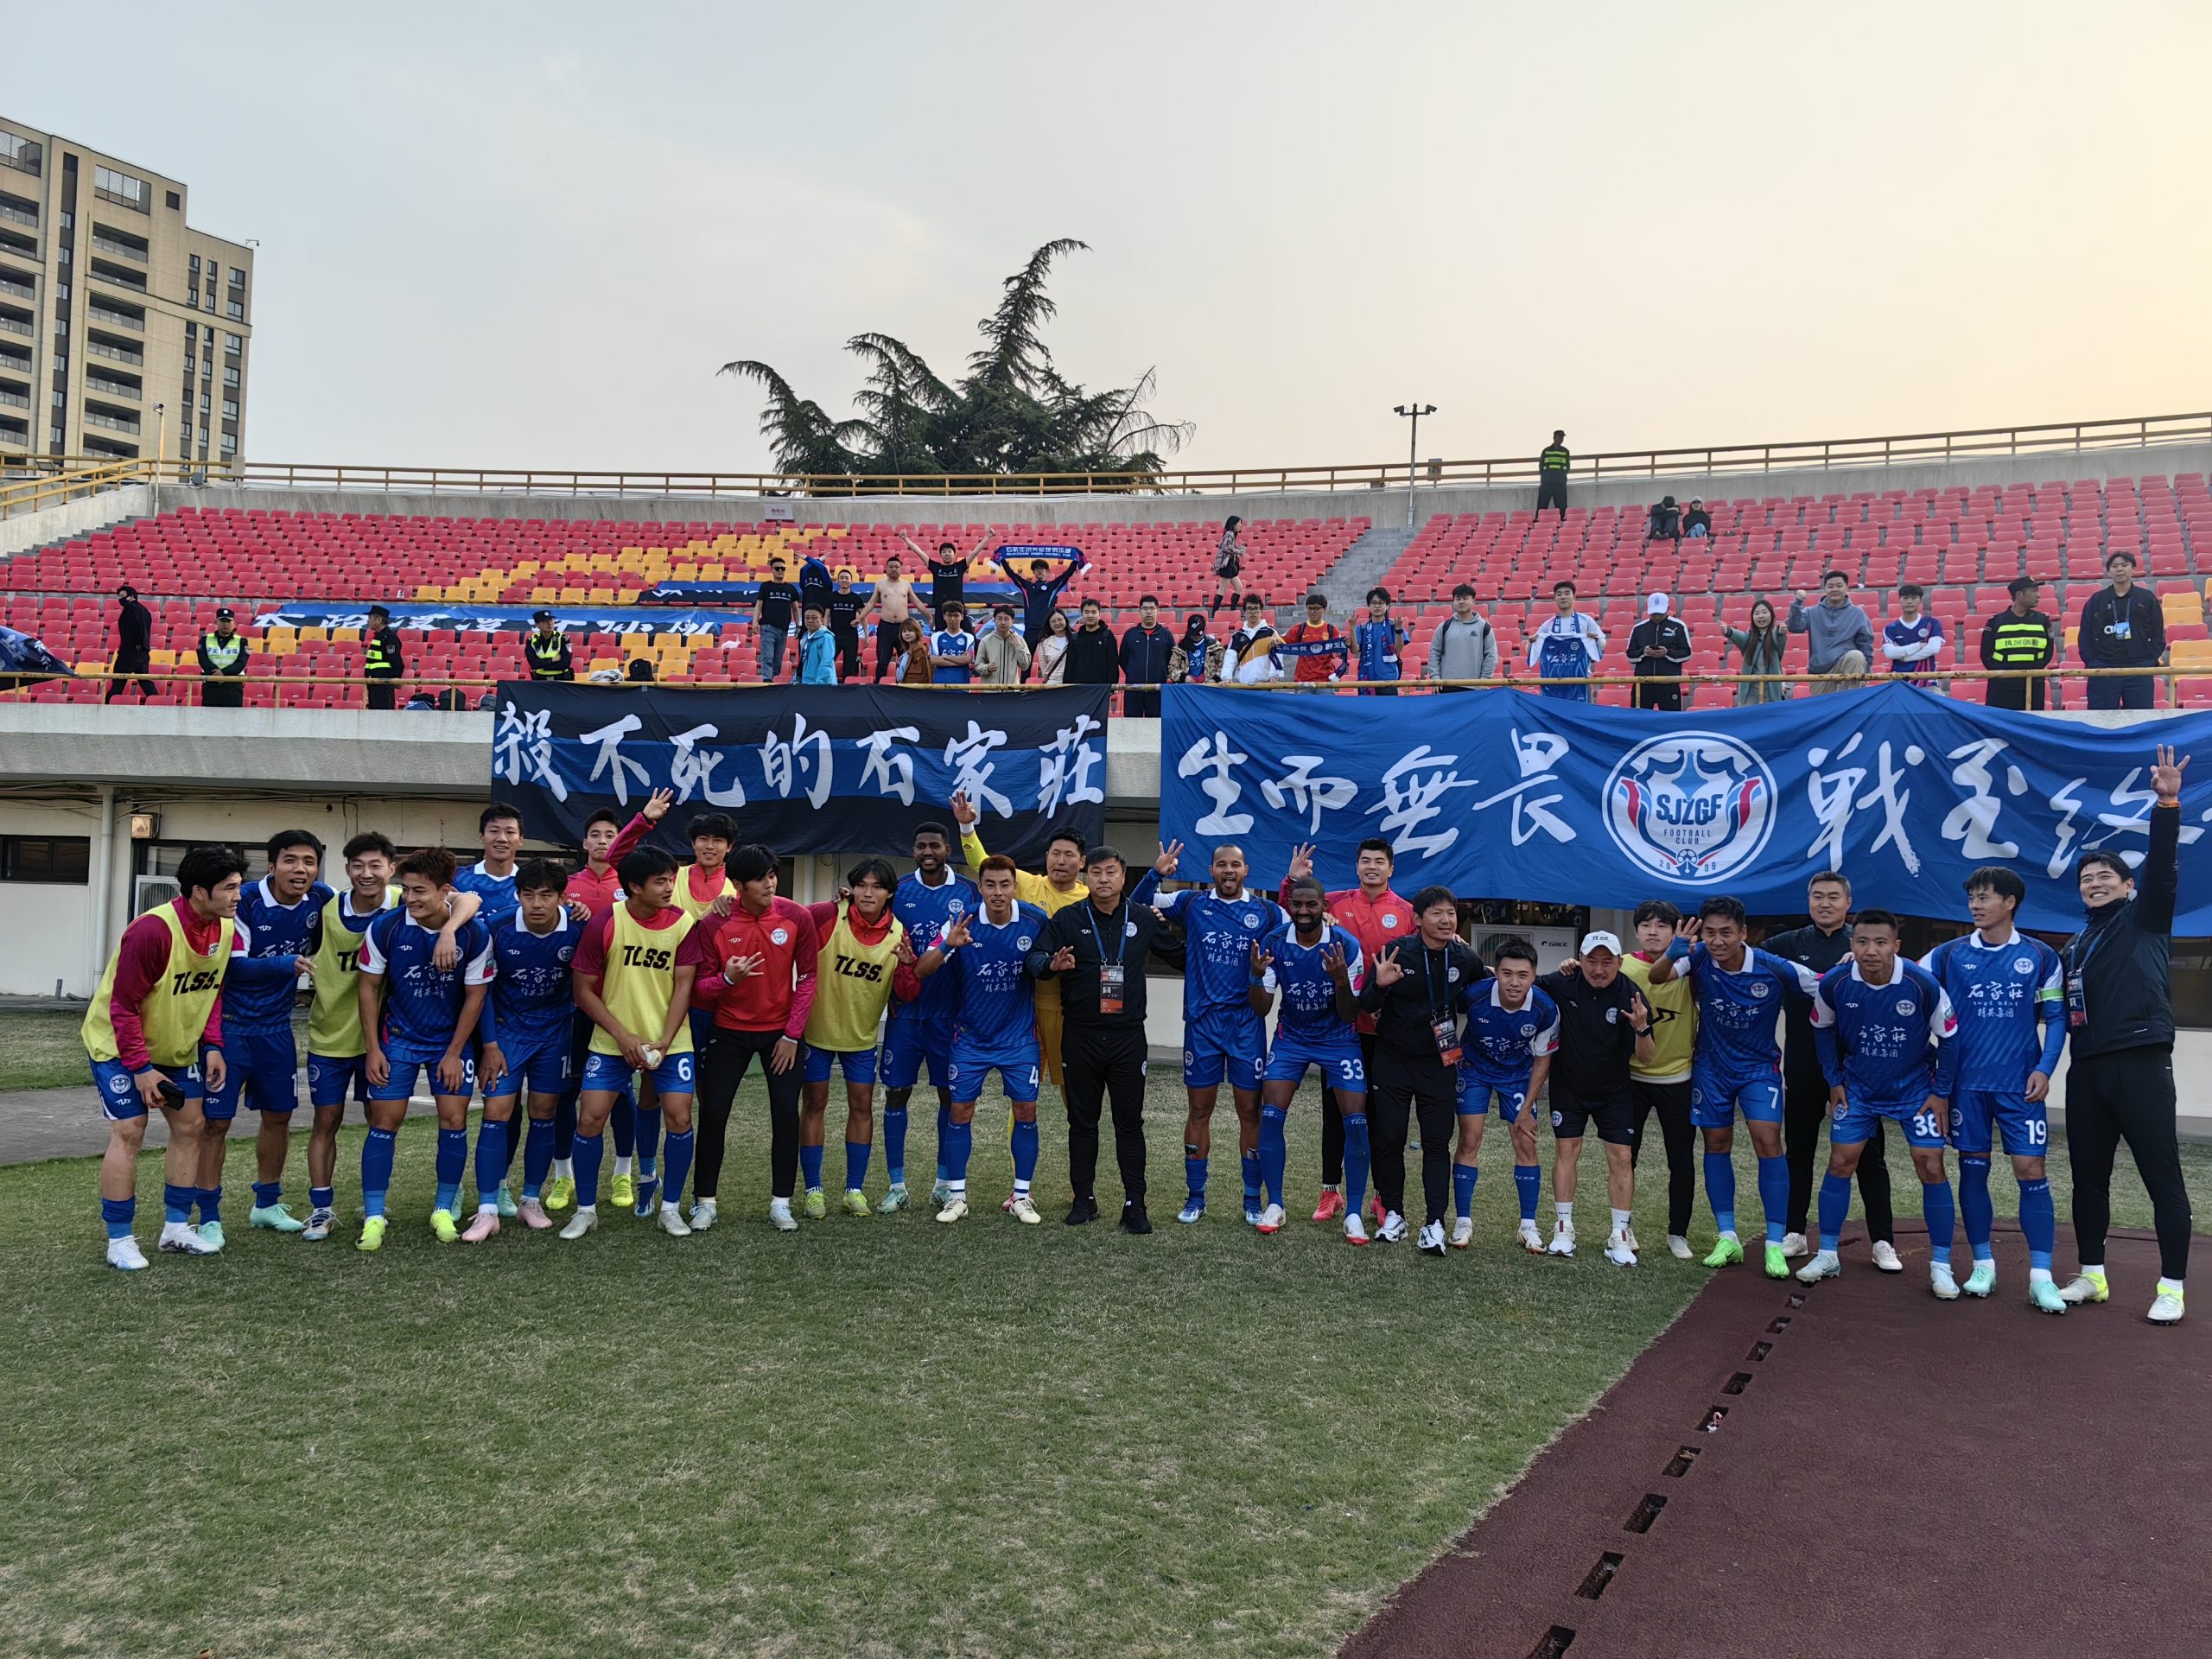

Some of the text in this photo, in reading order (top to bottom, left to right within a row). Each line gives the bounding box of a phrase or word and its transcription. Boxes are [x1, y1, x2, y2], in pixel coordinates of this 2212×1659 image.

[1656, 793, 1724, 826] SJZGF
[1663, 829, 1712, 837] FOOTBALL
[1659, 859, 1716, 872] 20 09
[187, 1064, 203, 1083] 4
[677, 1058, 692, 1081] 6
[1028, 1065, 1039, 1088] 4
[1255, 1058, 1264, 1079] 9
[1339, 1058, 1364, 1080] 33
[1767, 1086, 1779, 1109] 7
[2024, 1119, 2047, 1145] 19
